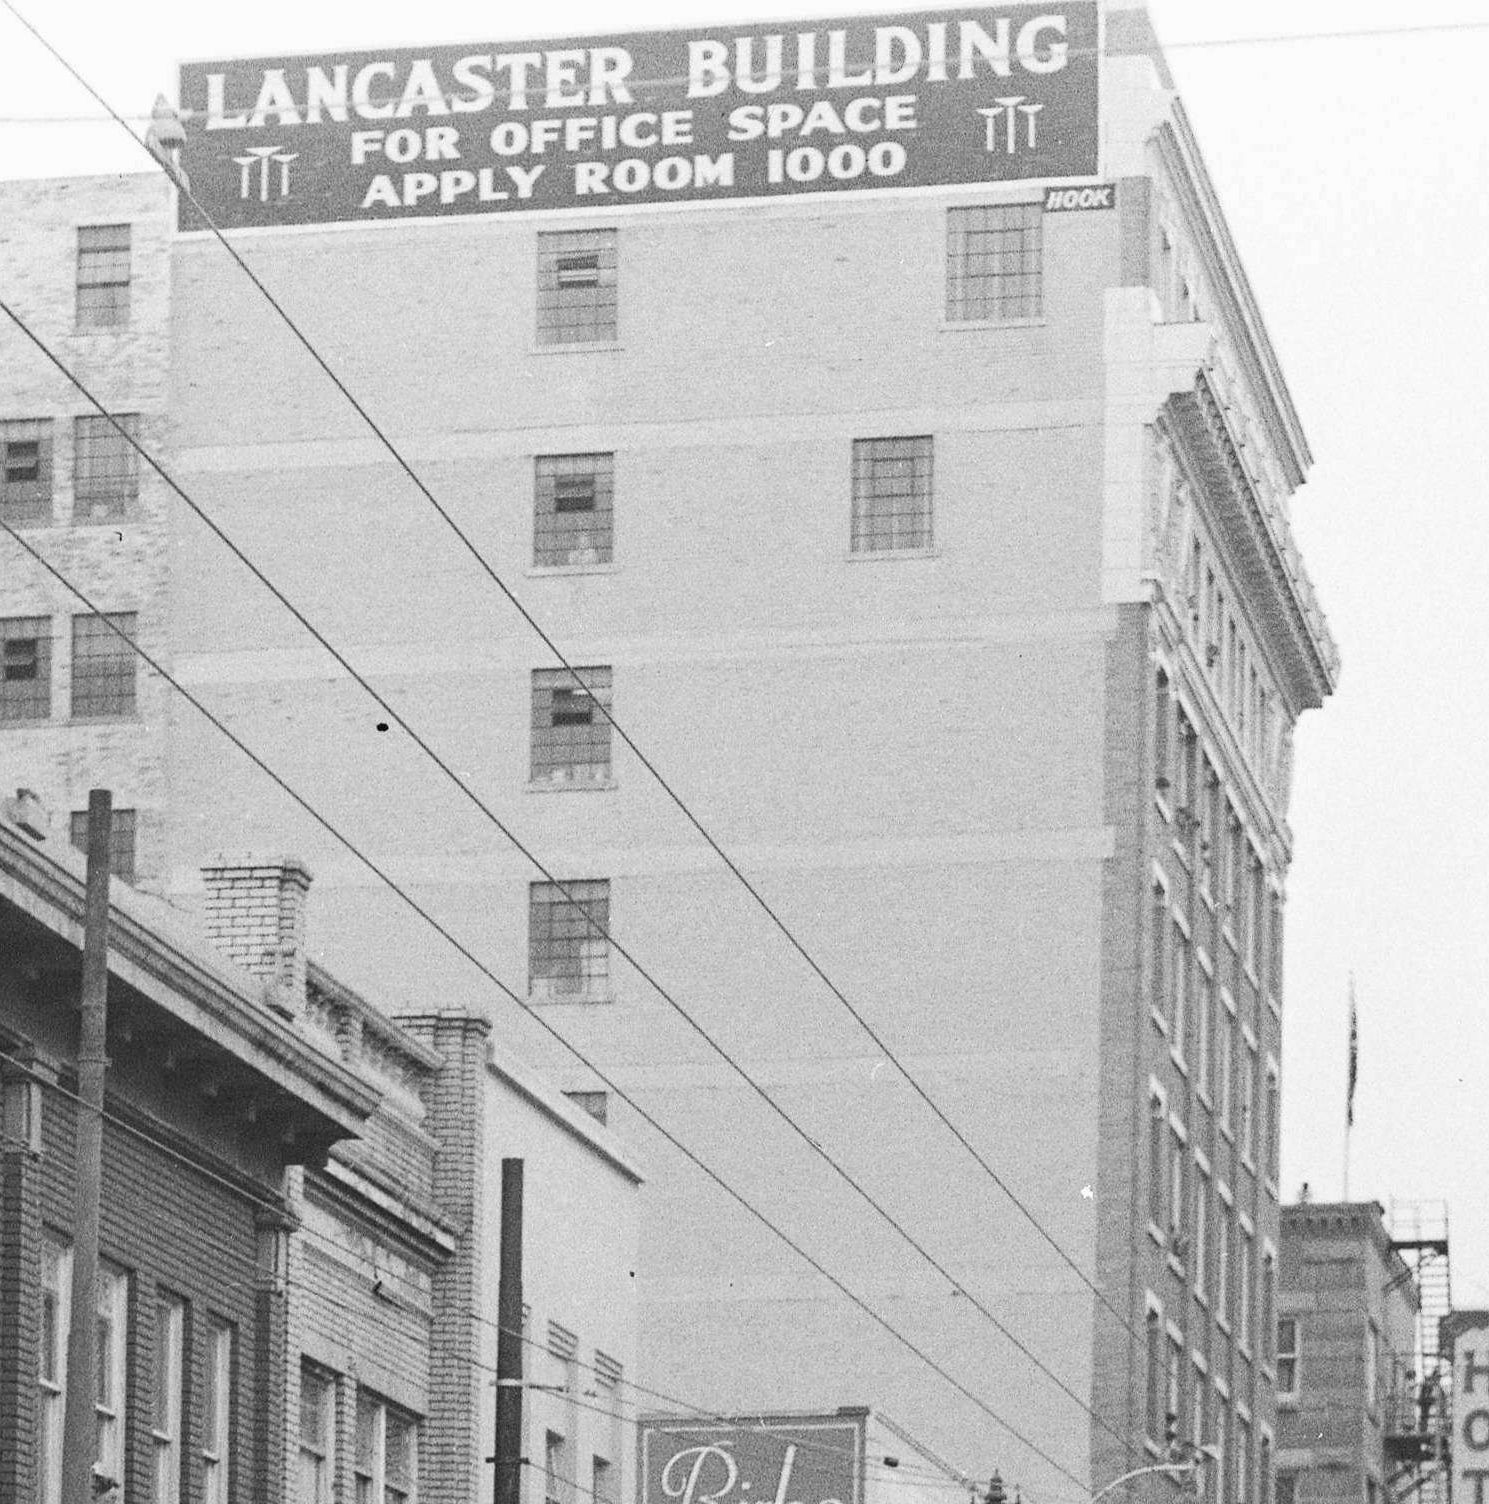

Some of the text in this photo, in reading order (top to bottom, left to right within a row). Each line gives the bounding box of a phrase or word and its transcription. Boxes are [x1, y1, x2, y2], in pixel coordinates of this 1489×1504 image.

[205, 13, 1069, 131] LANCASTER BUILDING
[351, 95, 917, 164] FOR OFFICE SPACE
[361, 141, 907, 208] APPLY ROOM 1000
[1046, 189, 1111, 209] HOOK
